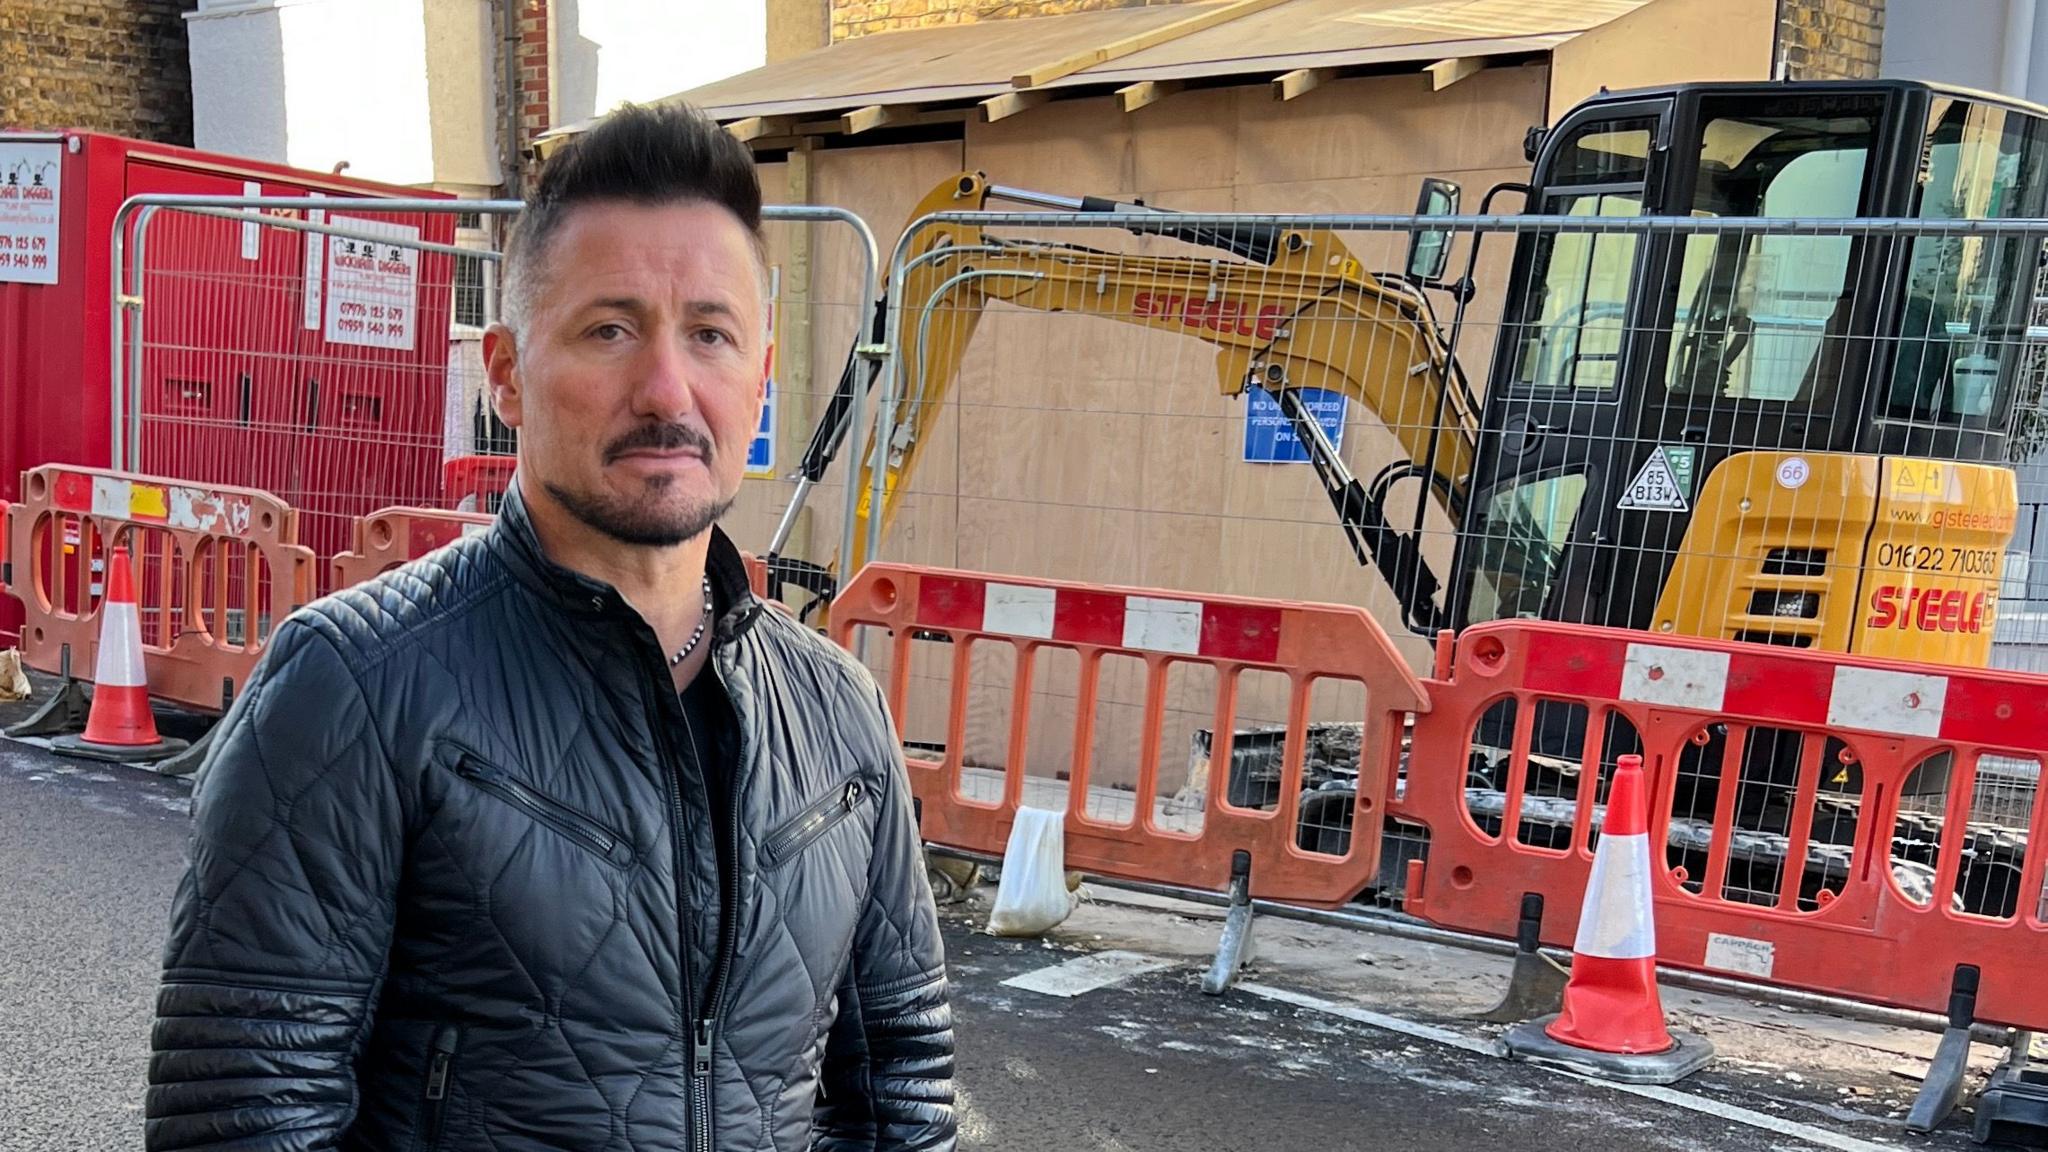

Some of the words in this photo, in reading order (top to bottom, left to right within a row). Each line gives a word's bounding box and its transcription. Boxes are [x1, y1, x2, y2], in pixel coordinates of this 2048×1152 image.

[15, 236, 29, 250] 125
[32, 237, 46, 251] 679
[14, 254, 29, 269] 540
[32, 254, 47, 270] 999
[388, 306, 403, 321] 679
[1133, 292, 1285, 341] STEELE
[367, 320, 384, 336] 540
[1252, 401, 1267, 411] NO
[1275, 431, 1291, 442] ON
[1647, 470, 1664, 486] 85
[1782, 465, 1803, 480] 66
[1878, 543, 1945, 571] 01622
[1867, 585, 1985, 634] STEELE
